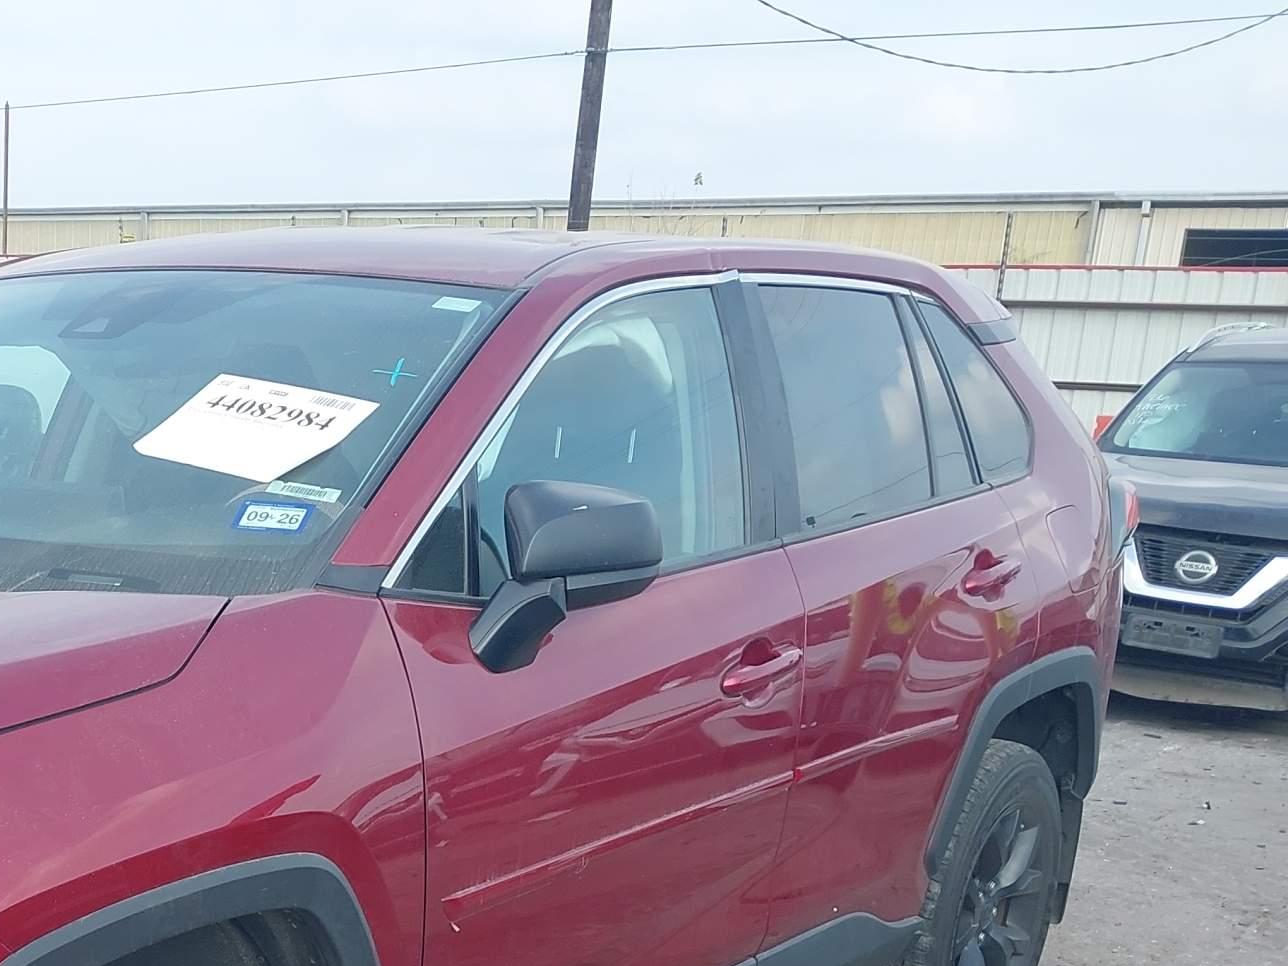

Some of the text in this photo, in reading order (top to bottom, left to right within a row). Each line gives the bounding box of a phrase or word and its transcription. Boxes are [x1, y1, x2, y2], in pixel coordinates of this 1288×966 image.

[207, 394, 336, 430] 44082984
[246, 511, 301, 525] 09 26
[1178, 561, 1213, 572] NISSAN
